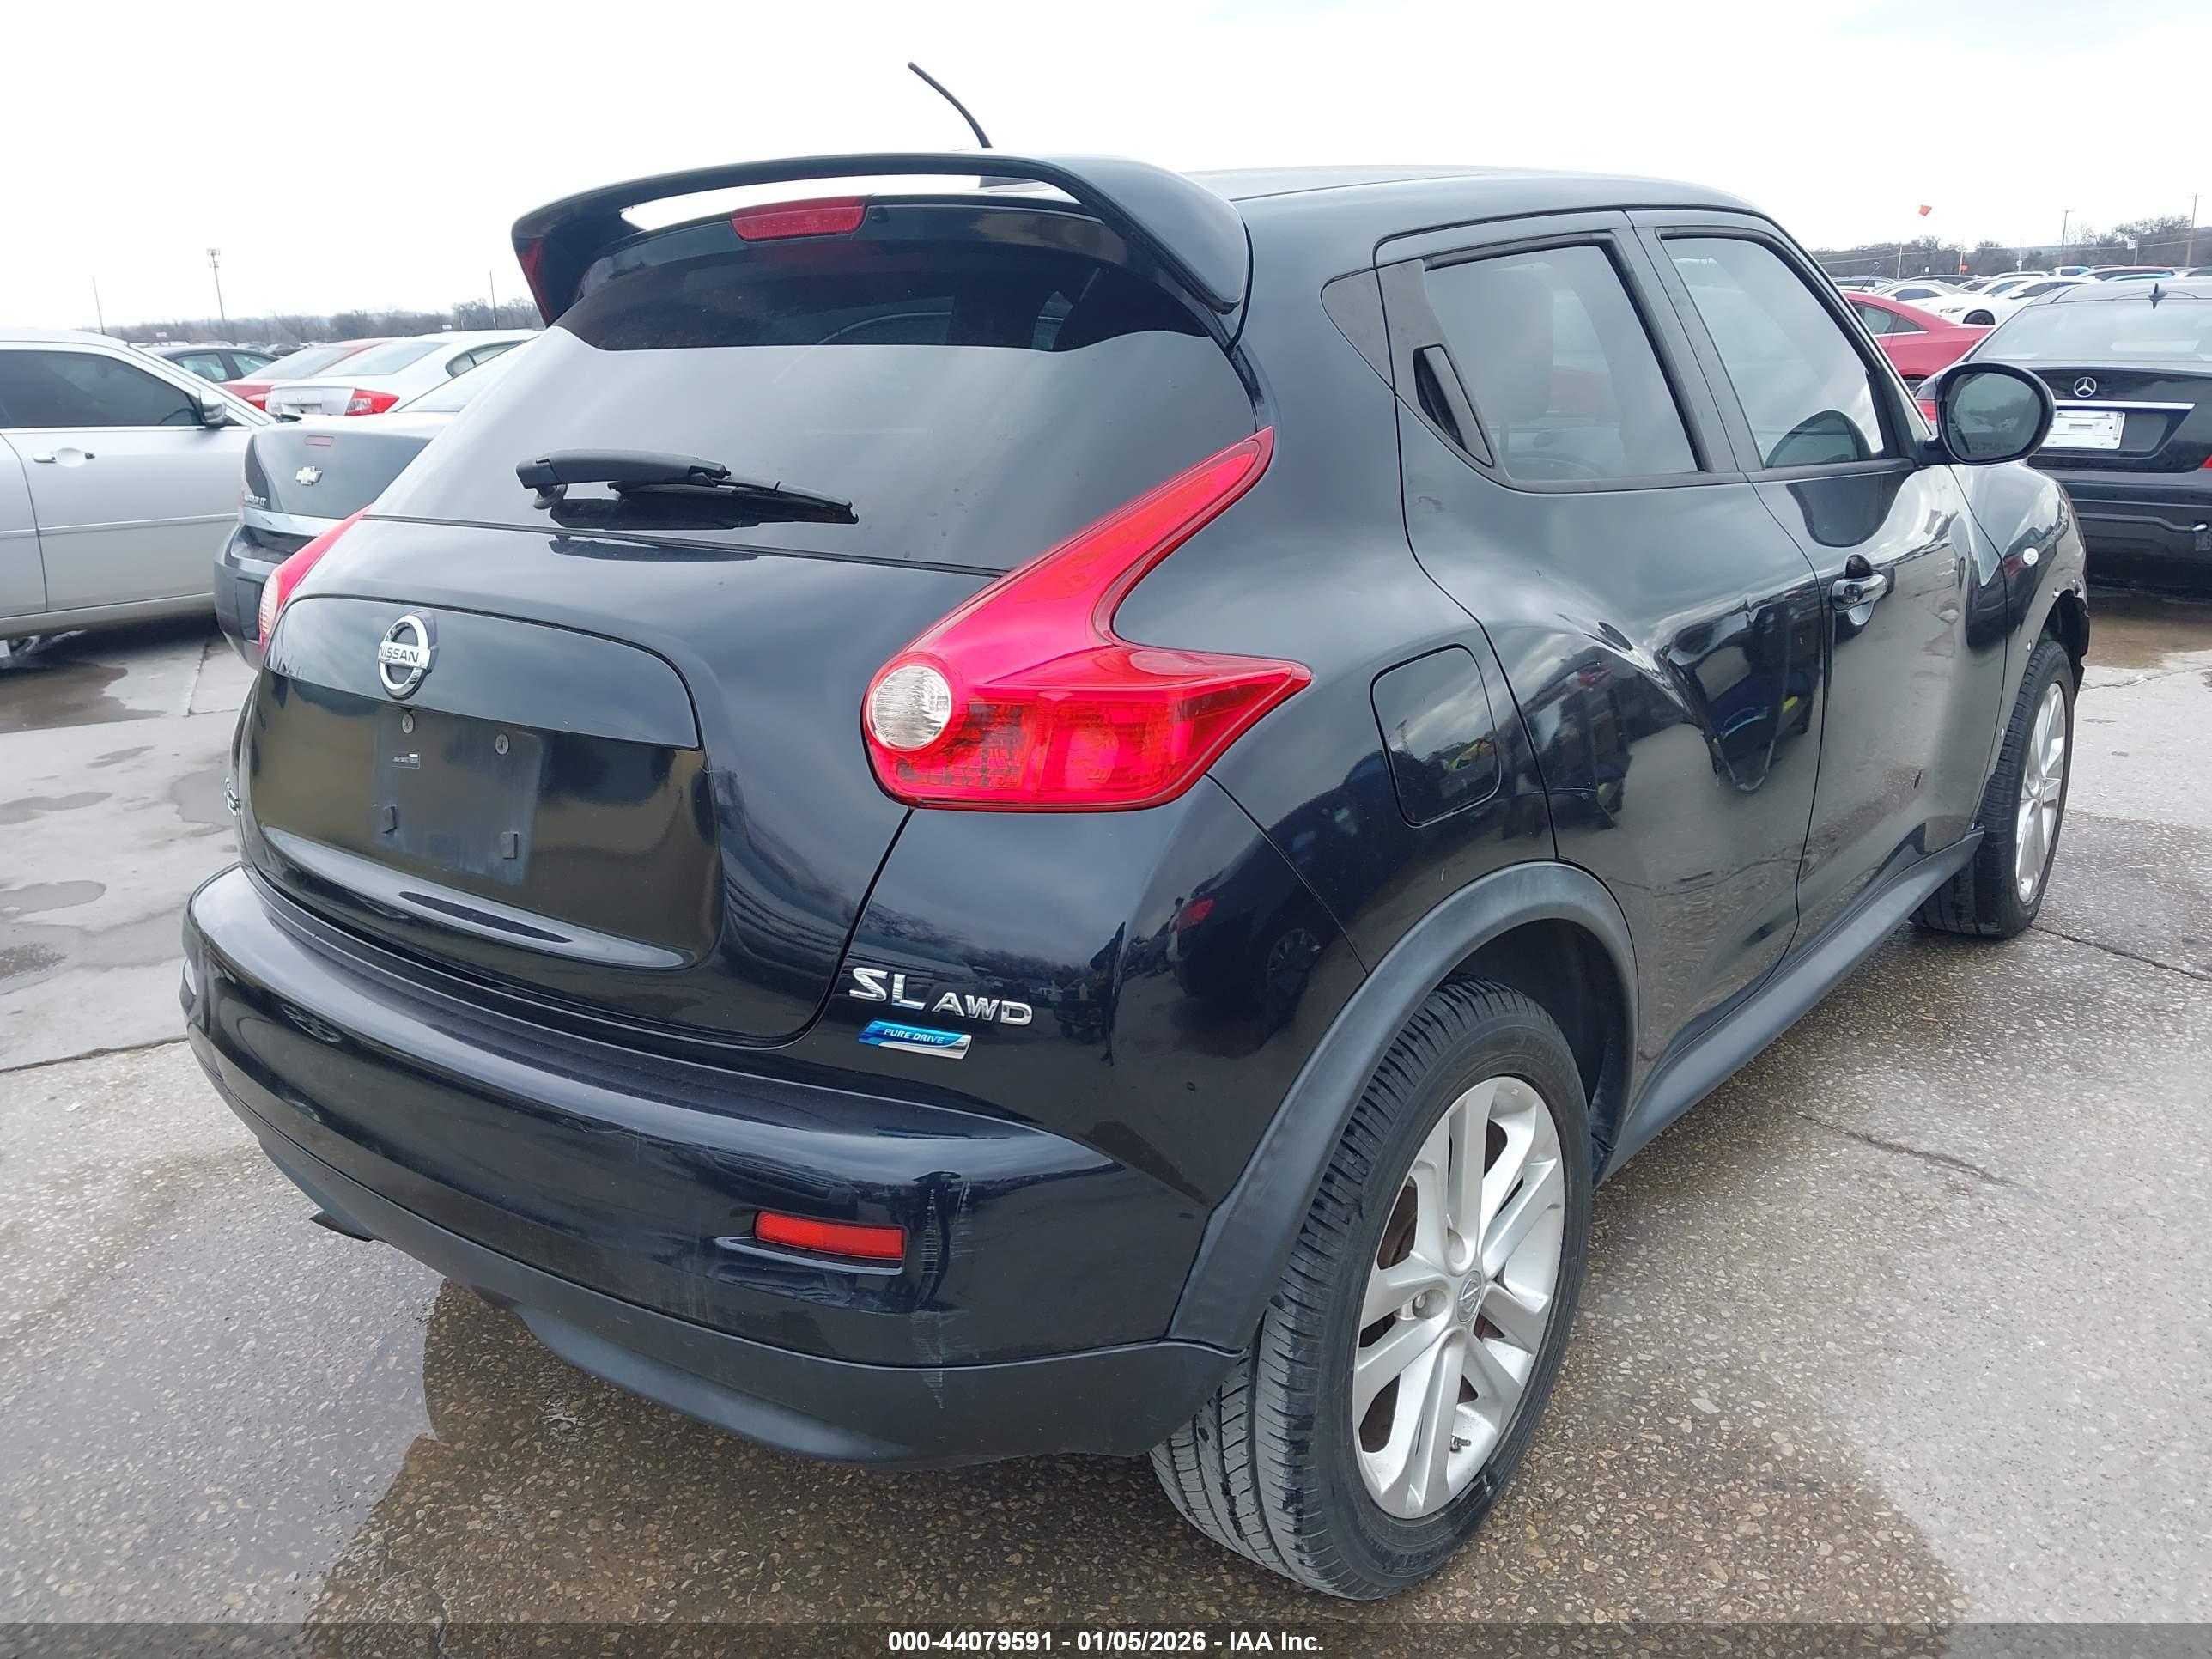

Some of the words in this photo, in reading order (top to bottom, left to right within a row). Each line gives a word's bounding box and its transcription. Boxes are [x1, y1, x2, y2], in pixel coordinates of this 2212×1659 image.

[380, 646, 420, 663] NISSAN
[848, 967, 926, 1011] SL
[931, 991, 1034, 1027] AWD
[883, 1028, 912, 1040] PURE
[913, 1032, 945, 1044] DRIVE
